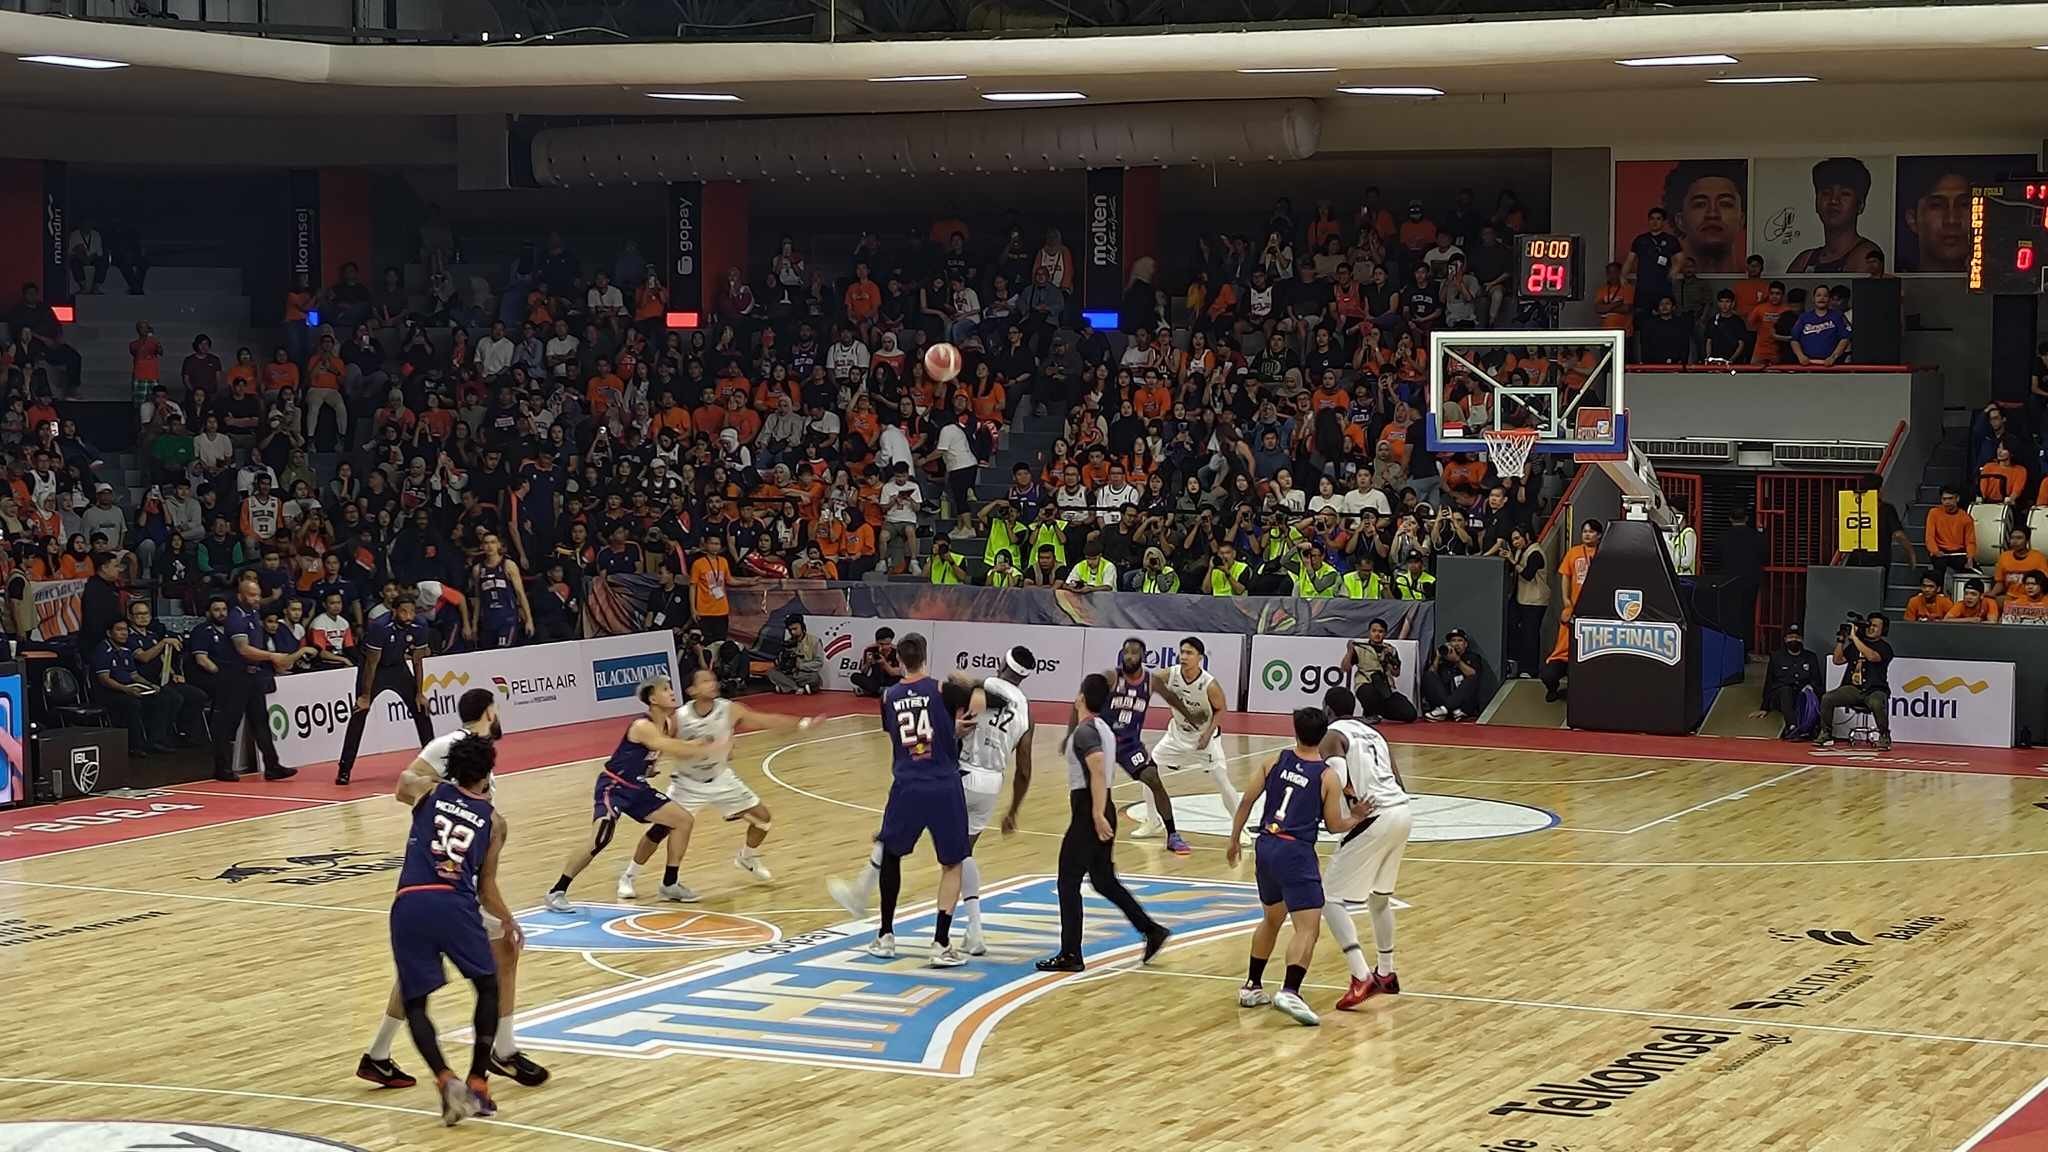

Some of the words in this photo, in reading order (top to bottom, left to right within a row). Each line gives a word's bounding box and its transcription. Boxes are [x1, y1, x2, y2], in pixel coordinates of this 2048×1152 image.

[680, 196, 693, 251] gopay
[1092, 194, 1107, 265] molten
[1530, 240, 1570, 258] 10:00
[2016, 247, 2032, 269] 0
[1527, 263, 1564, 291] 24
[1846, 516, 1872, 529] C2
[1581, 625, 1614, 652] THE
[1615, 627, 1676, 658] FINALS
[511, 677, 554, 695] PELITA
[556, 673, 577, 689] AIR
[596, 662, 669, 688] BLACKMORES
[897, 709, 933, 744] 24
[988, 709, 1015, 733] 32
[74, 752, 89, 764] IBL
[13, 803, 205, 833] 2024
[1274, 786, 1294, 821] 1
[431, 814, 475, 863] 32
[747, 927, 850, 956] gopay
[1487, 1025, 1742, 1118] Telkomsel
